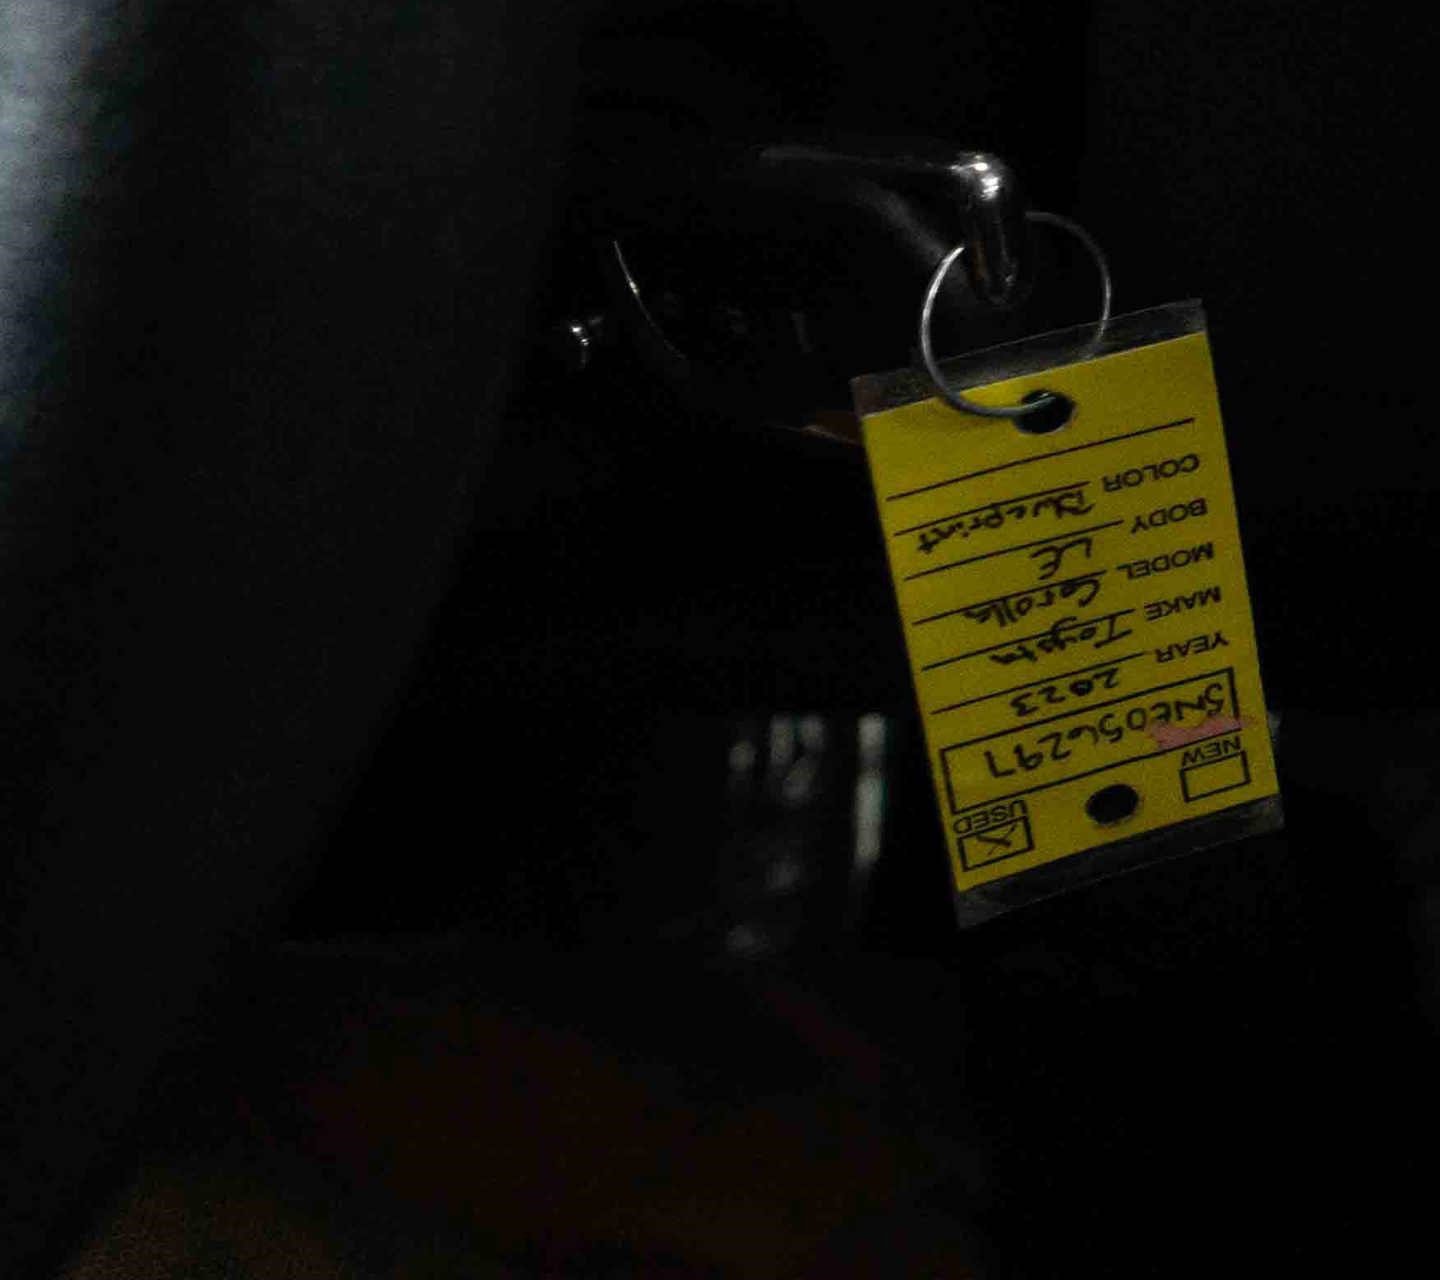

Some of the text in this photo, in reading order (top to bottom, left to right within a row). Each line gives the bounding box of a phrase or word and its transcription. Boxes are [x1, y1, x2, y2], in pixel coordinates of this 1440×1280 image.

[1101, 453, 1200, 493] COLOR
[1131, 497, 1208, 534] BODY
[1116, 542, 1214, 580] MODEL
[1144, 586, 1221, 621] MAKE
[1009, 630, 1230, 717] YEAR 2023
[1181, 736, 1242, 765] NEW
[952, 799, 1028, 835] USED
